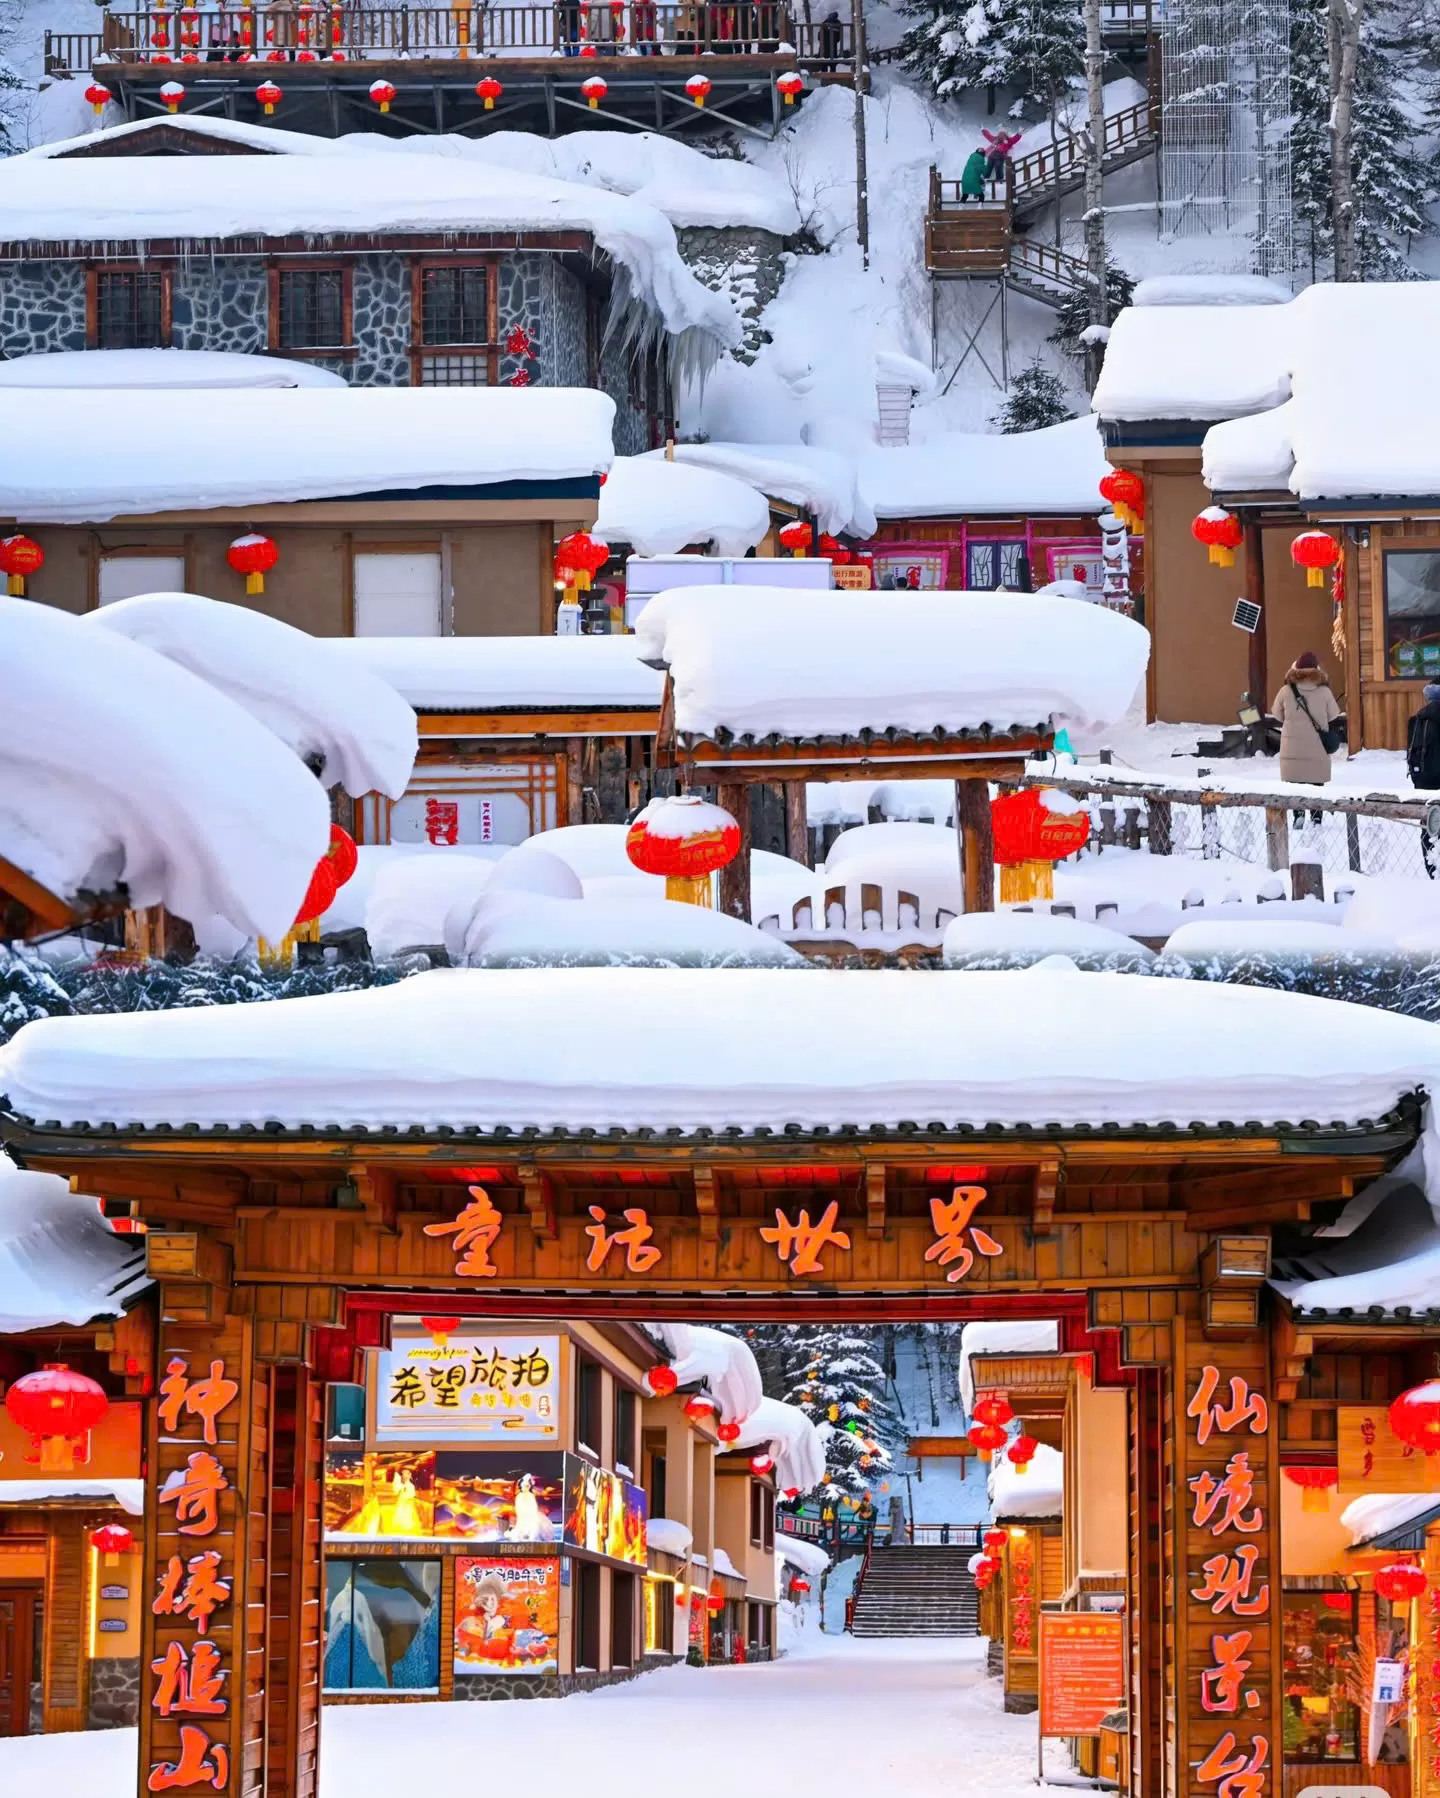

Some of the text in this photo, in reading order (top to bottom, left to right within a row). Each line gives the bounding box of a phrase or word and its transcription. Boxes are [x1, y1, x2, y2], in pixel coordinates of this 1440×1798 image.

[423, 1185, 1003, 1282] 童话世界
[390, 1346, 550, 1408] 希望旅拍
